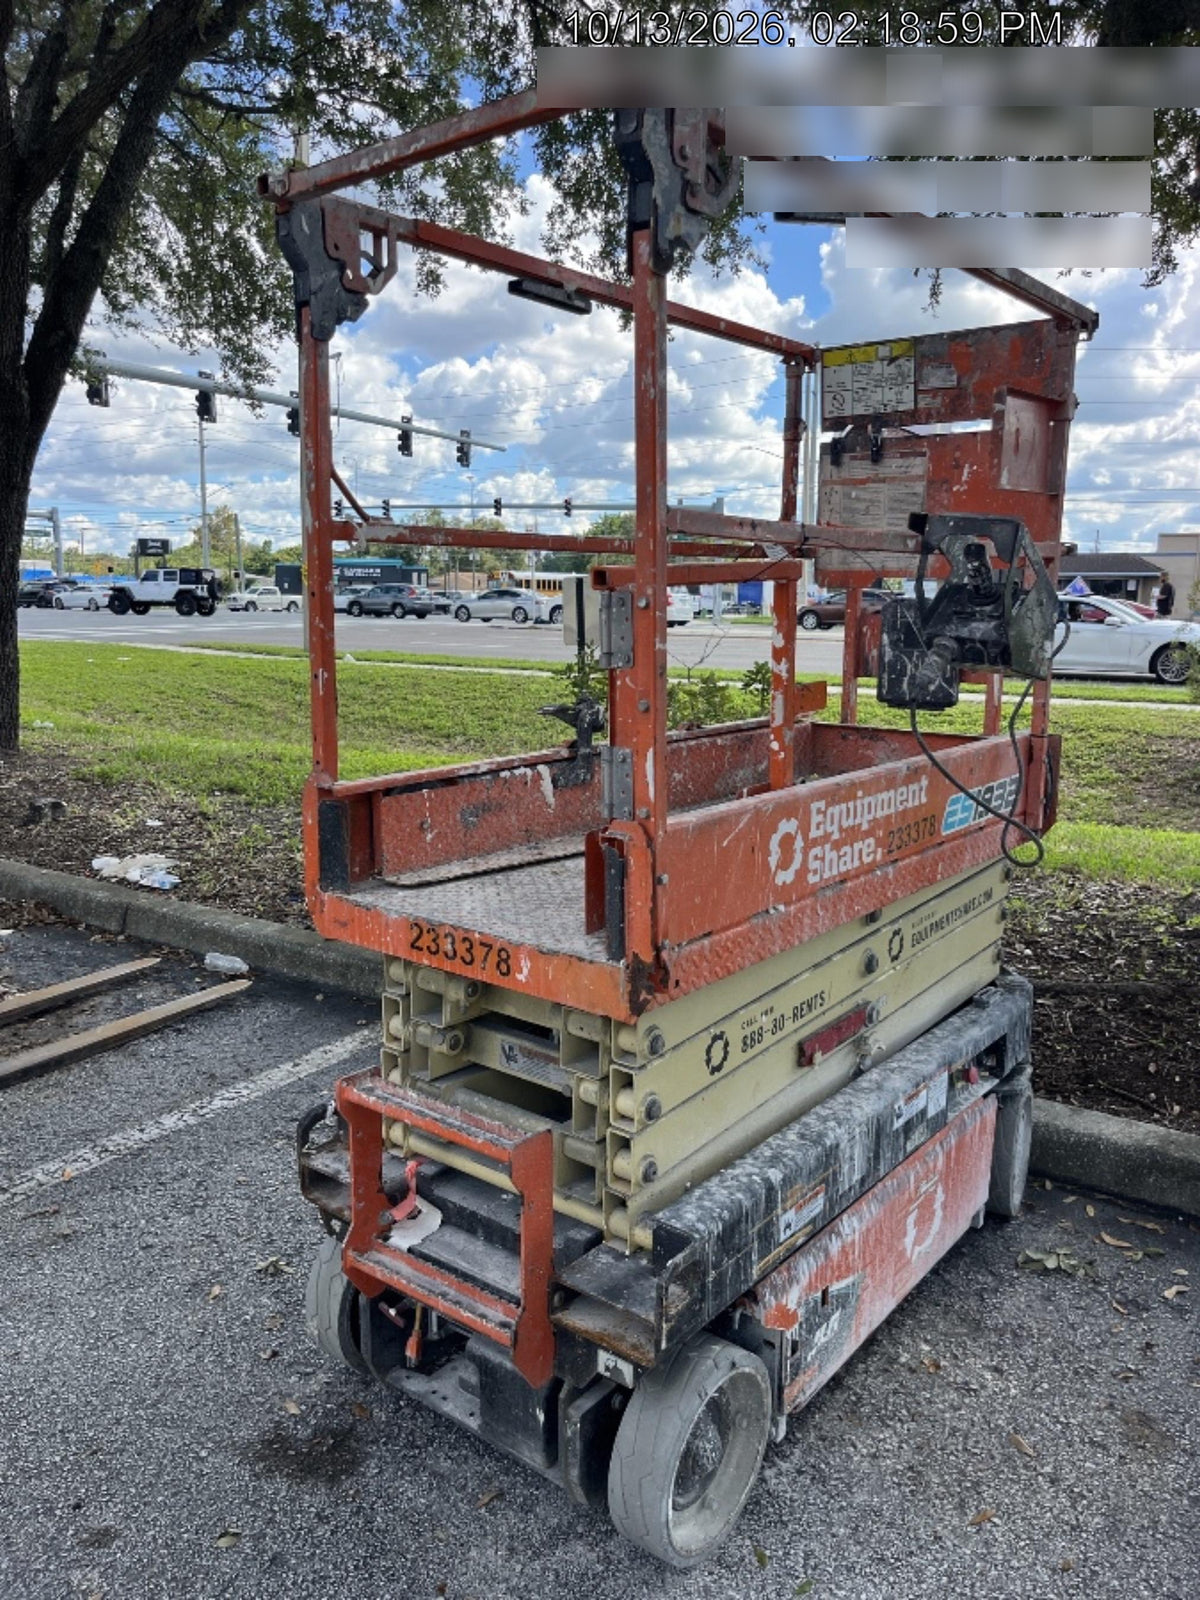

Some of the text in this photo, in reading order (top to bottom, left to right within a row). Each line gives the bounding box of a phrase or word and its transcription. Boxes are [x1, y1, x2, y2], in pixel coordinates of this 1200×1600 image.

[809, 775, 928, 839] Equipment
[887, 814, 936, 854] 233378
[410, 922, 511, 977] 233378
